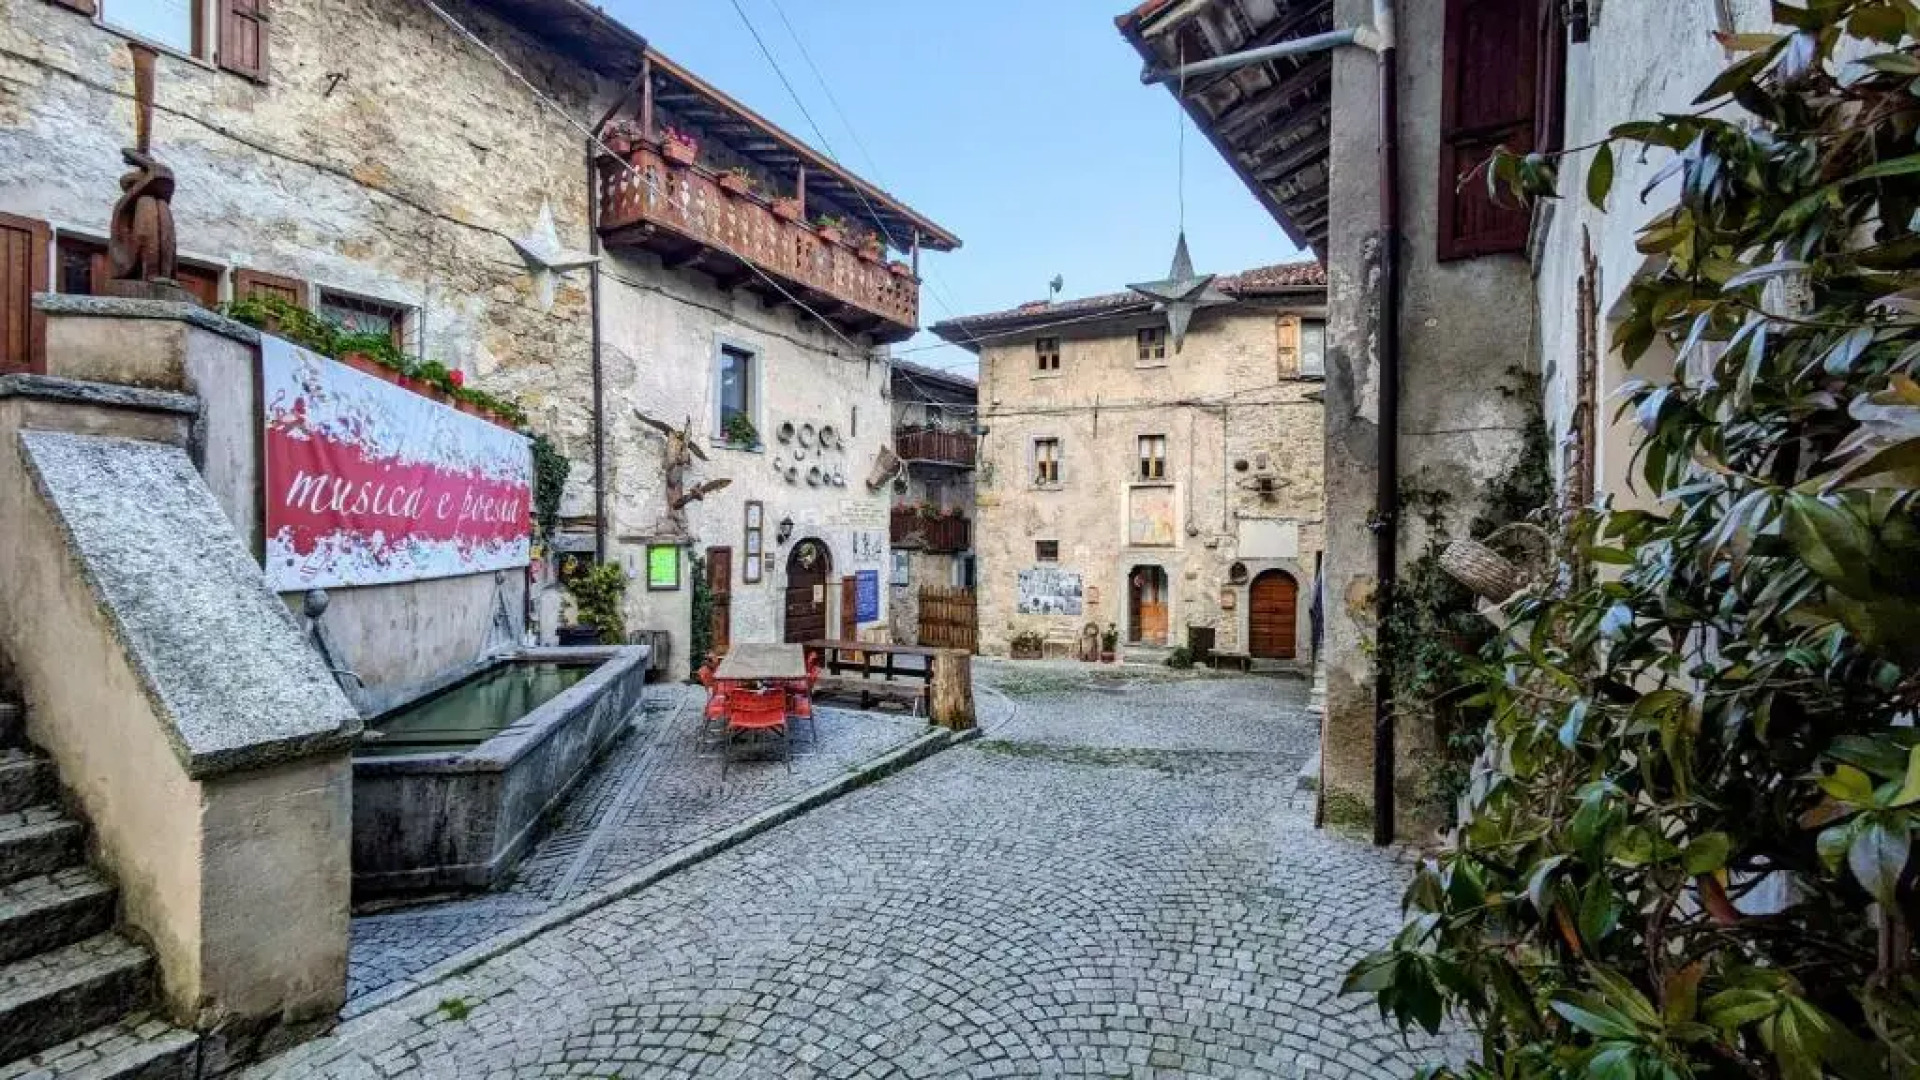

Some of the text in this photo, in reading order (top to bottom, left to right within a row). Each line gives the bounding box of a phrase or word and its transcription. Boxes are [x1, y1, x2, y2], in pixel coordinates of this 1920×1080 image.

[286, 470, 519, 534] musica e poesia
